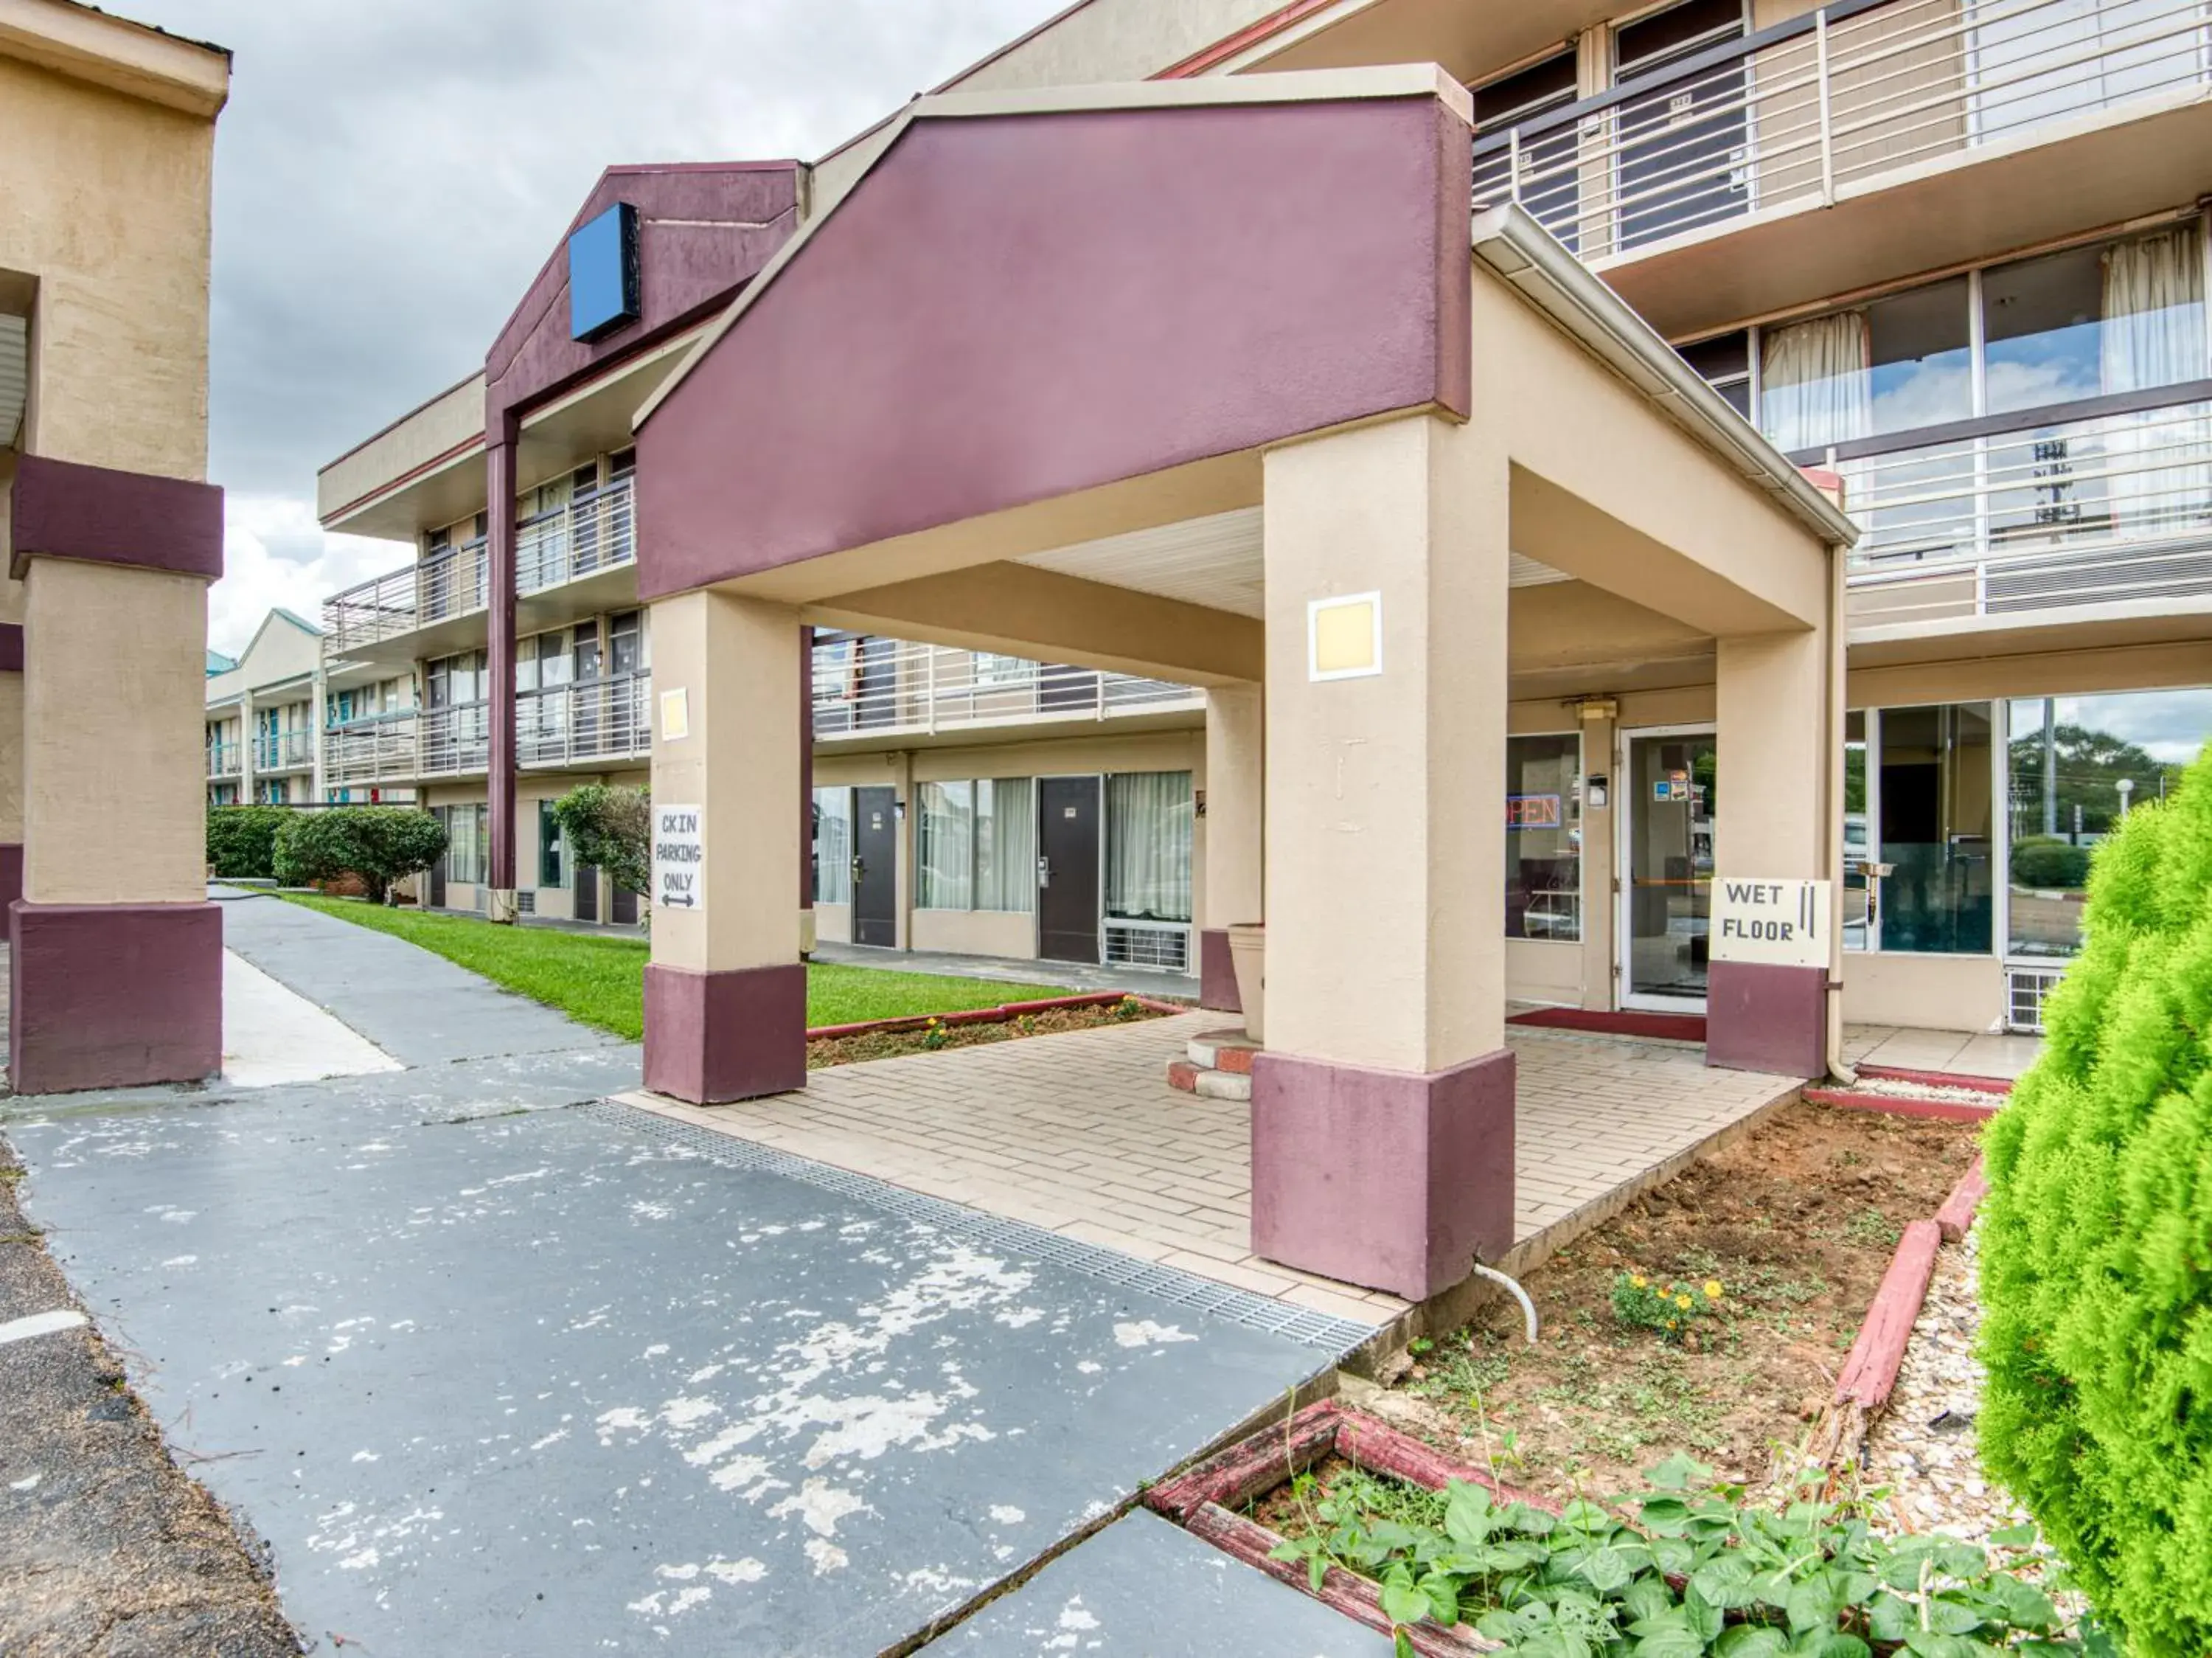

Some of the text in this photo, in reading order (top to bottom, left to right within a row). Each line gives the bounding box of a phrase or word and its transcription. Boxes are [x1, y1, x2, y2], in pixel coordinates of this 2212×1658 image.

[1506, 799, 1557, 823] PEN
[655, 843, 701, 863] PARKING
[664, 873, 693, 892] ONLY
[1726, 884, 1784, 905] WET
[1722, 919, 1793, 942] FLOOR
